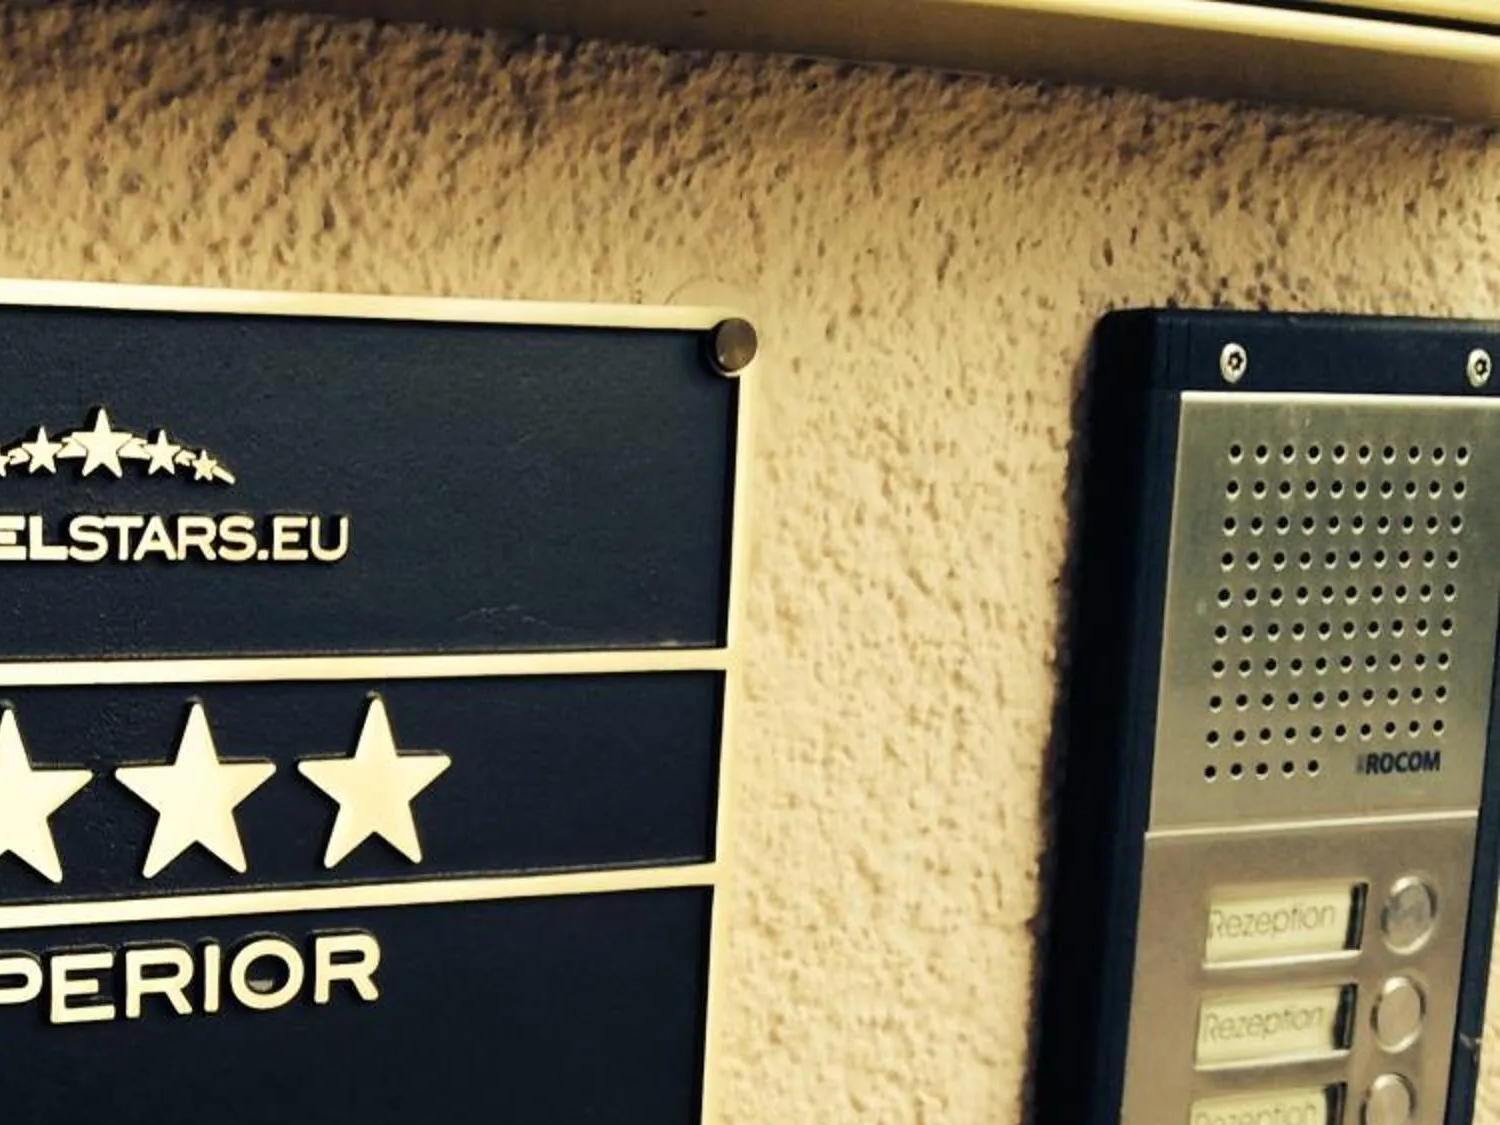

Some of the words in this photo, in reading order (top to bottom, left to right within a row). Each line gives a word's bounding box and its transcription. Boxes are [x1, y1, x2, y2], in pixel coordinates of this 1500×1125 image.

[1365, 750, 1441, 775] ROCOM
[1209, 904, 1337, 939] Rezeption
[1204, 1006, 1326, 1042] Rezeption
